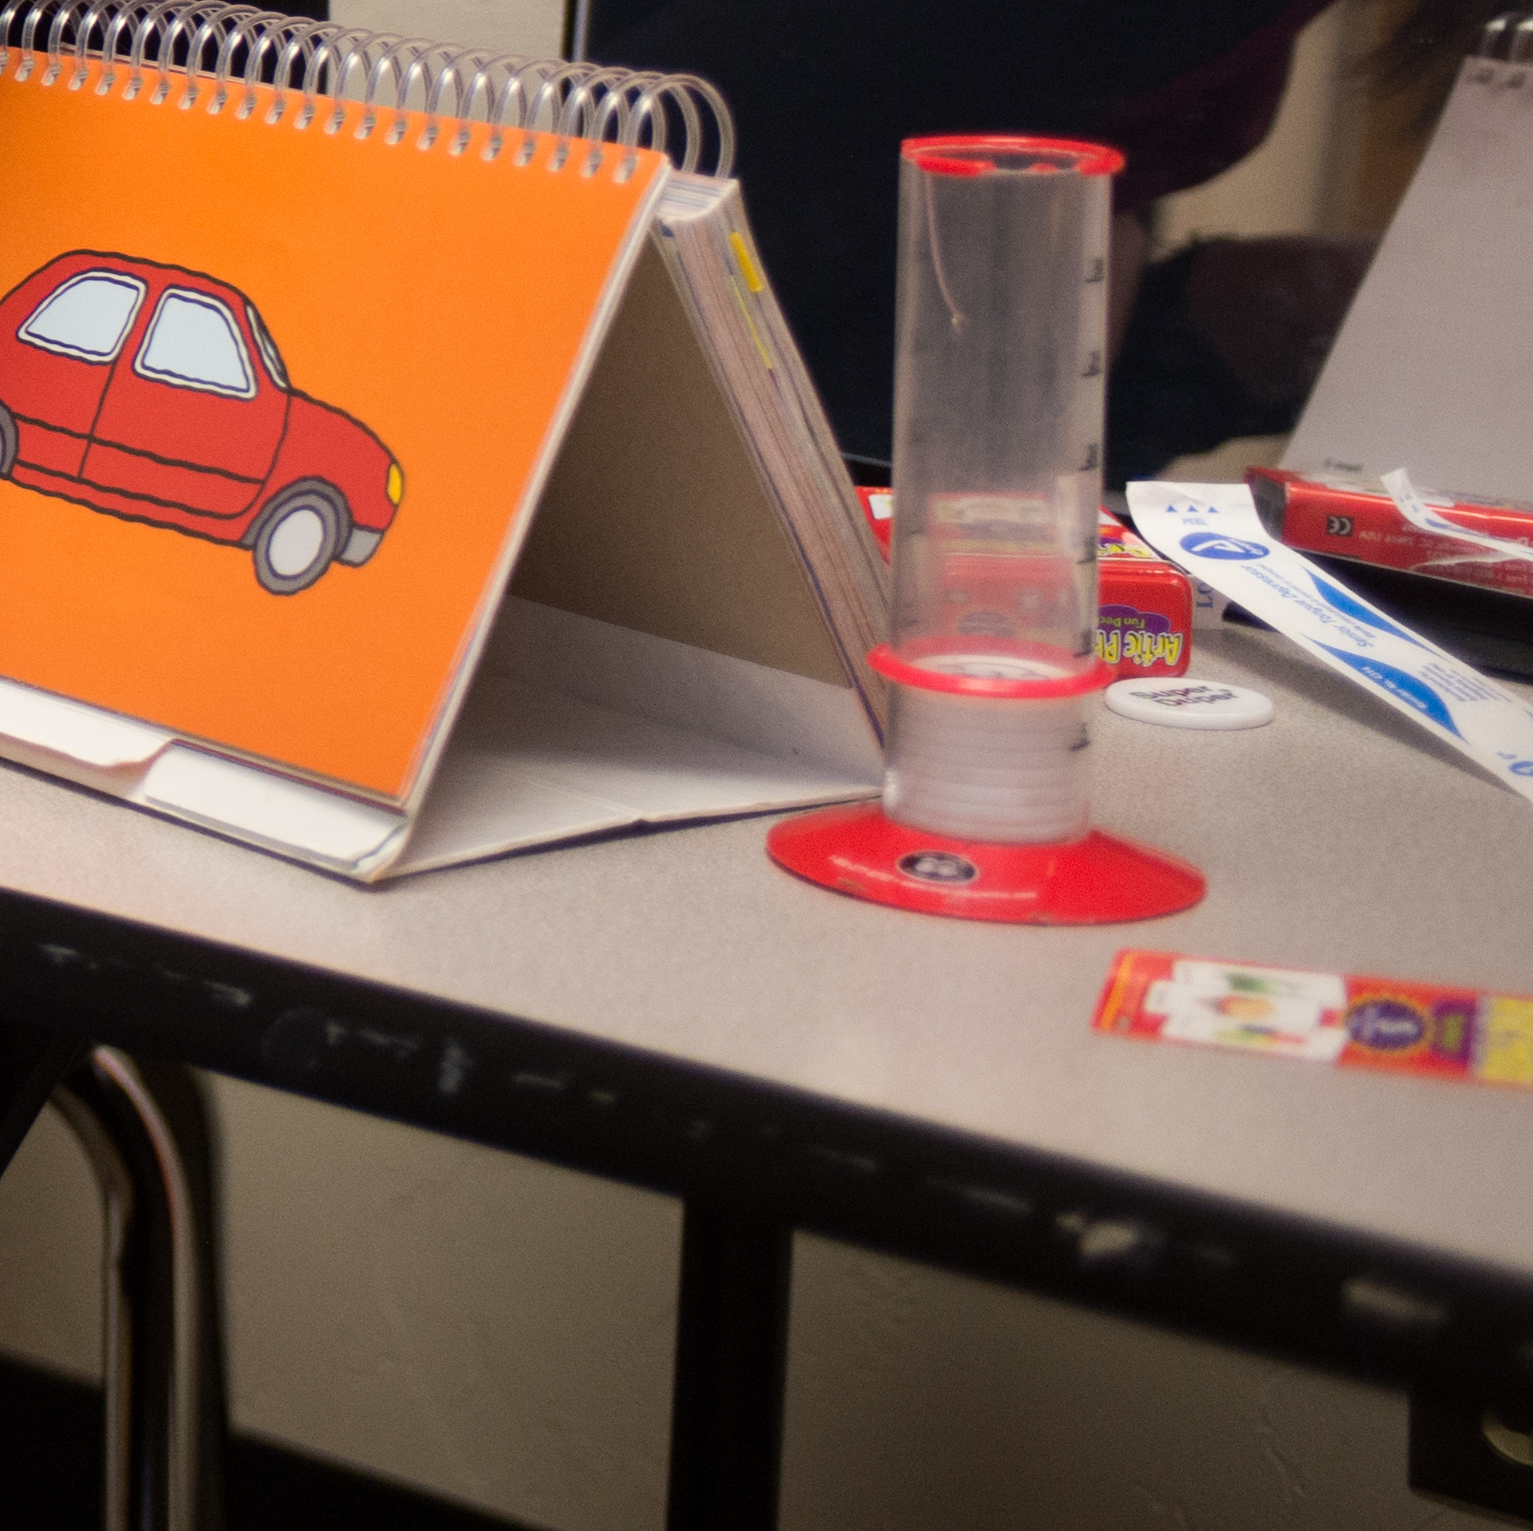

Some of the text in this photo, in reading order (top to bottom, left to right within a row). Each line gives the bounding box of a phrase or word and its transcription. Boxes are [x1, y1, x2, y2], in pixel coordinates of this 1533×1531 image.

[1124, 618, 1146, 629] Fun
[1123, 631, 1183, 667] Artic
[1129, 685, 1213, 699] Super
[1152, 692, 1239, 707] Duper
